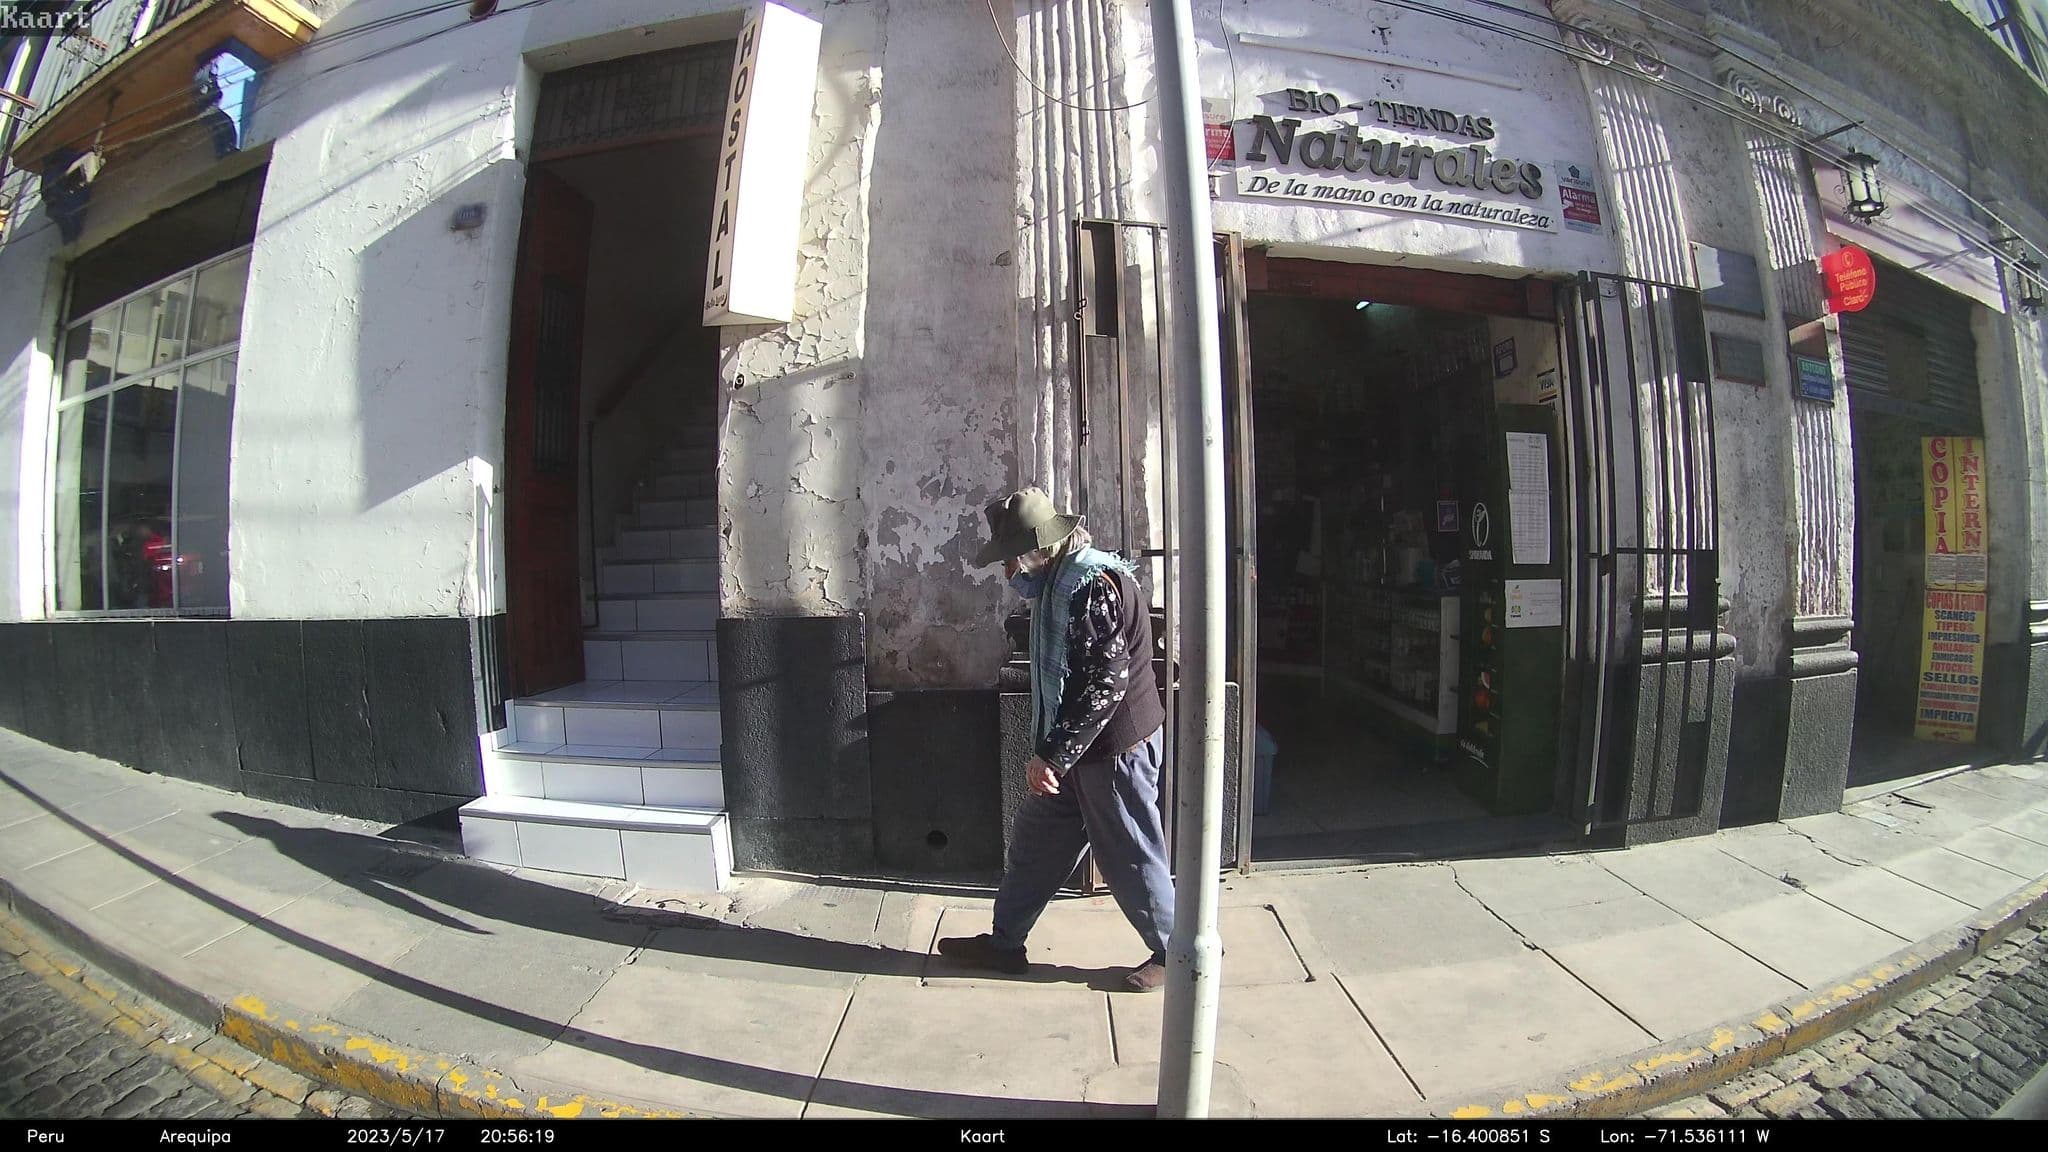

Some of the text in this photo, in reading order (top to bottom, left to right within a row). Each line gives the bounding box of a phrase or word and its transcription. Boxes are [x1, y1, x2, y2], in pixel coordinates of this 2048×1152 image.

[1286, 88, 1341, 115] BIO
[1369, 98, 1496, 141] TIENDAS
[712, 24, 756, 290] HOSTAL
[1245, 115, 1544, 200] Naturales
[1246, 176, 1281, 194] De
[1284, 178, 1308, 197] la
[1312, 184, 1376, 203] mano
[1379, 190, 1418, 210] con
[1421, 194, 1443, 212] la
[1447, 201, 1550, 229] naturaleza
[1562, 188, 1596, 204] Alarma
[1834, 267, 1867, 283] Teléfono
[1843, 294, 1865, 306] Claro
[1960, 438, 1981, 554] INTERN
[1926, 591, 1953, 610] COPIAS
[1934, 610, 1976, 622] SCANEOS
[1936, 621, 1975, 633] TIPEOS
[1928, 631, 1981, 643] IMPRESIONES
[1923, 671, 1979, 685] SELLOS
[1919, 708, 1974, 723] IMPRENTA
